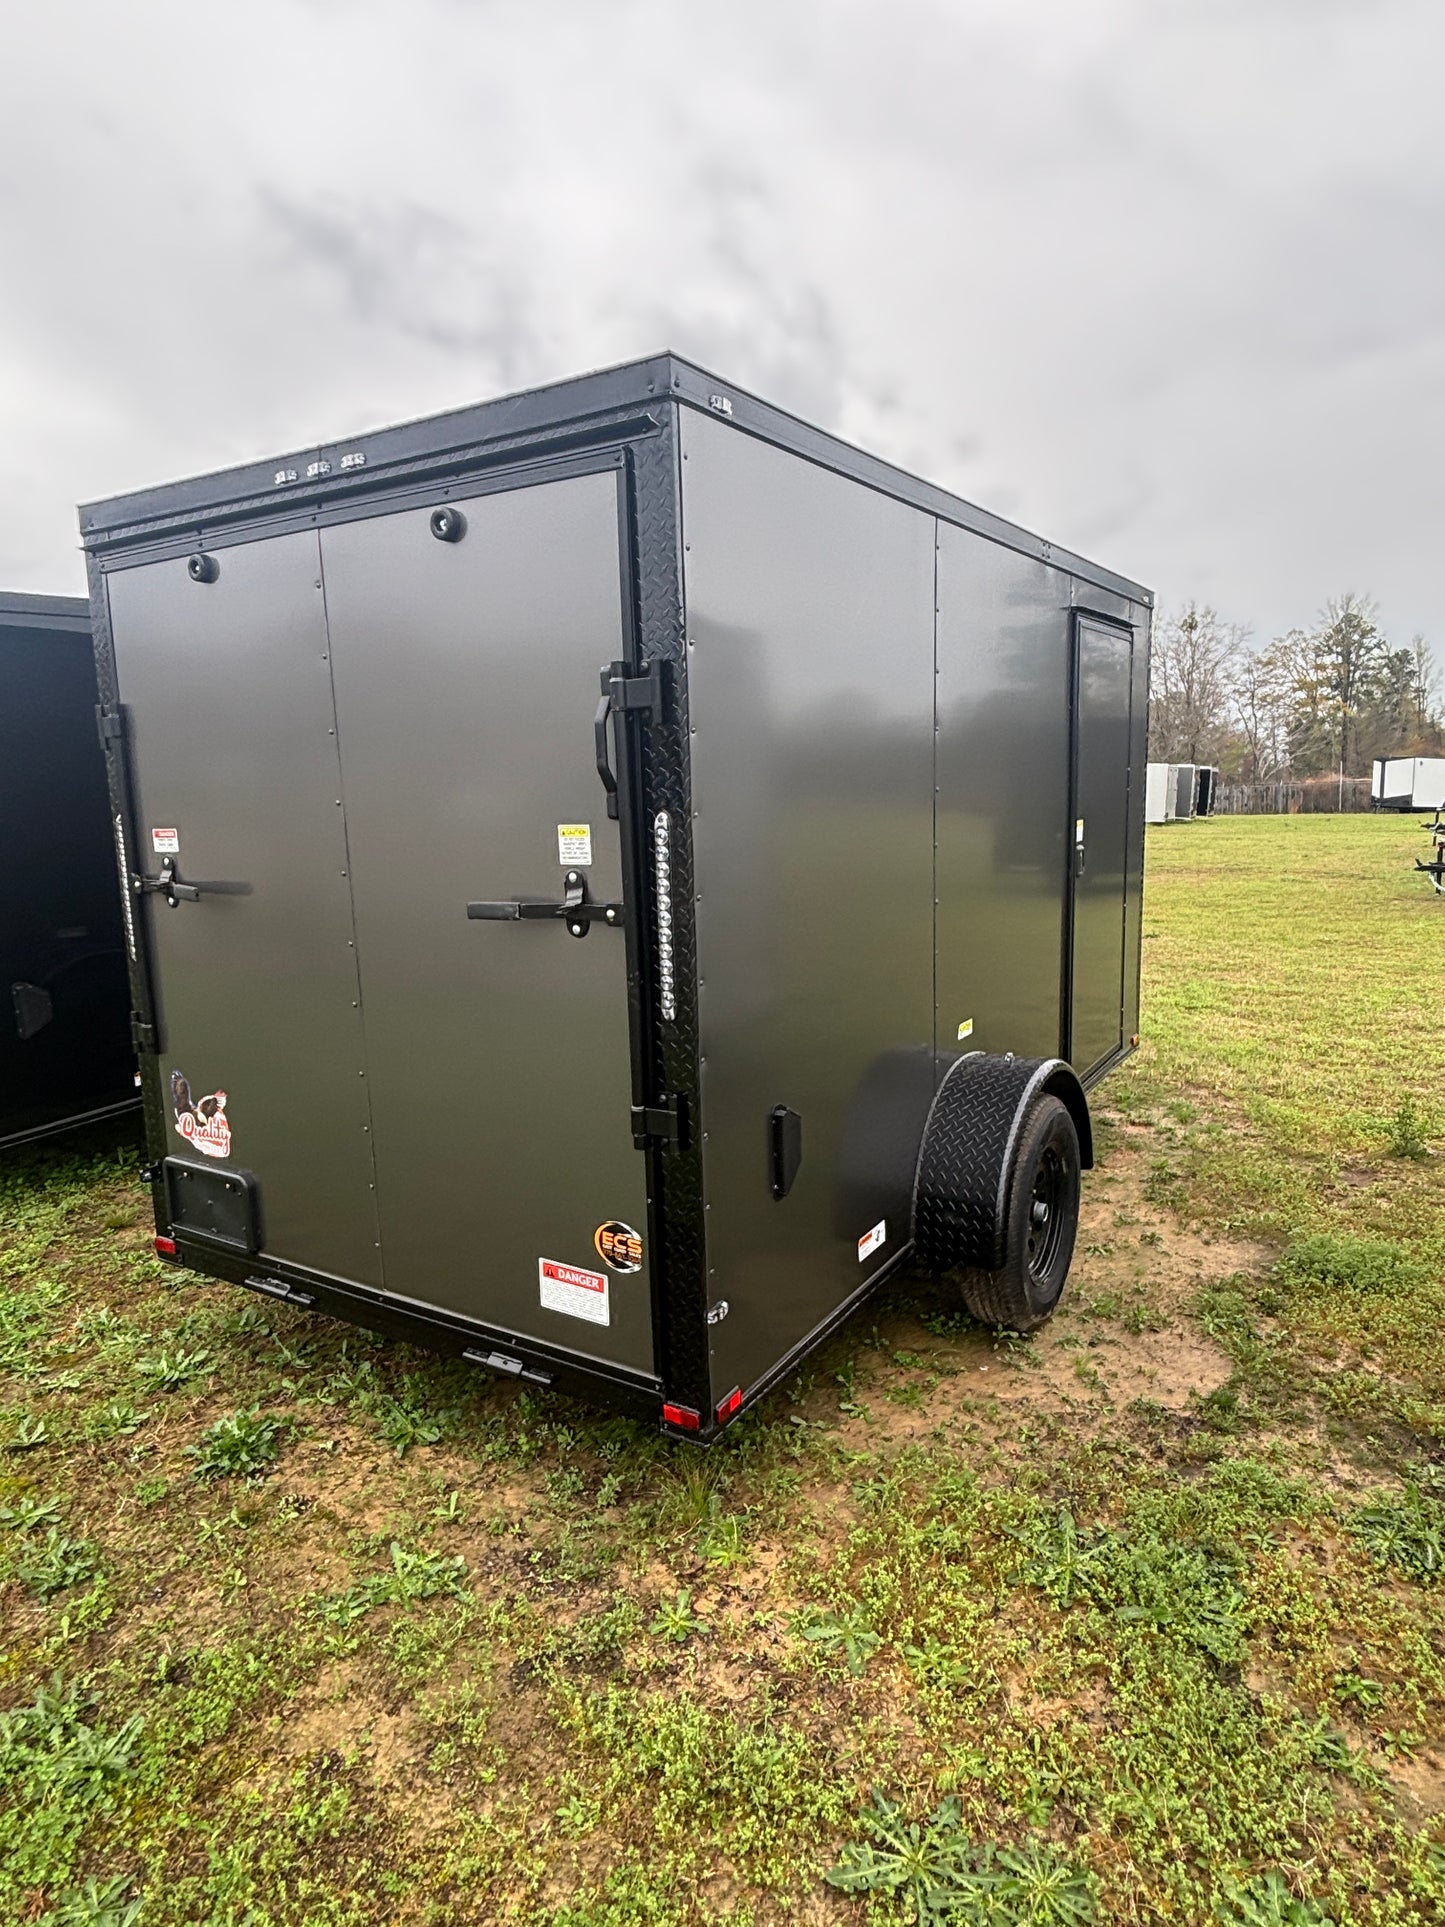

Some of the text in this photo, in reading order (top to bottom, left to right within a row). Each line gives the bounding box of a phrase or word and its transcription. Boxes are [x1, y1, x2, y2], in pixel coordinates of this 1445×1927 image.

[180, 1113, 229, 1155] Quality
[602, 1231, 642, 1254] ECS
[557, 1268, 599, 1289] DANGER
